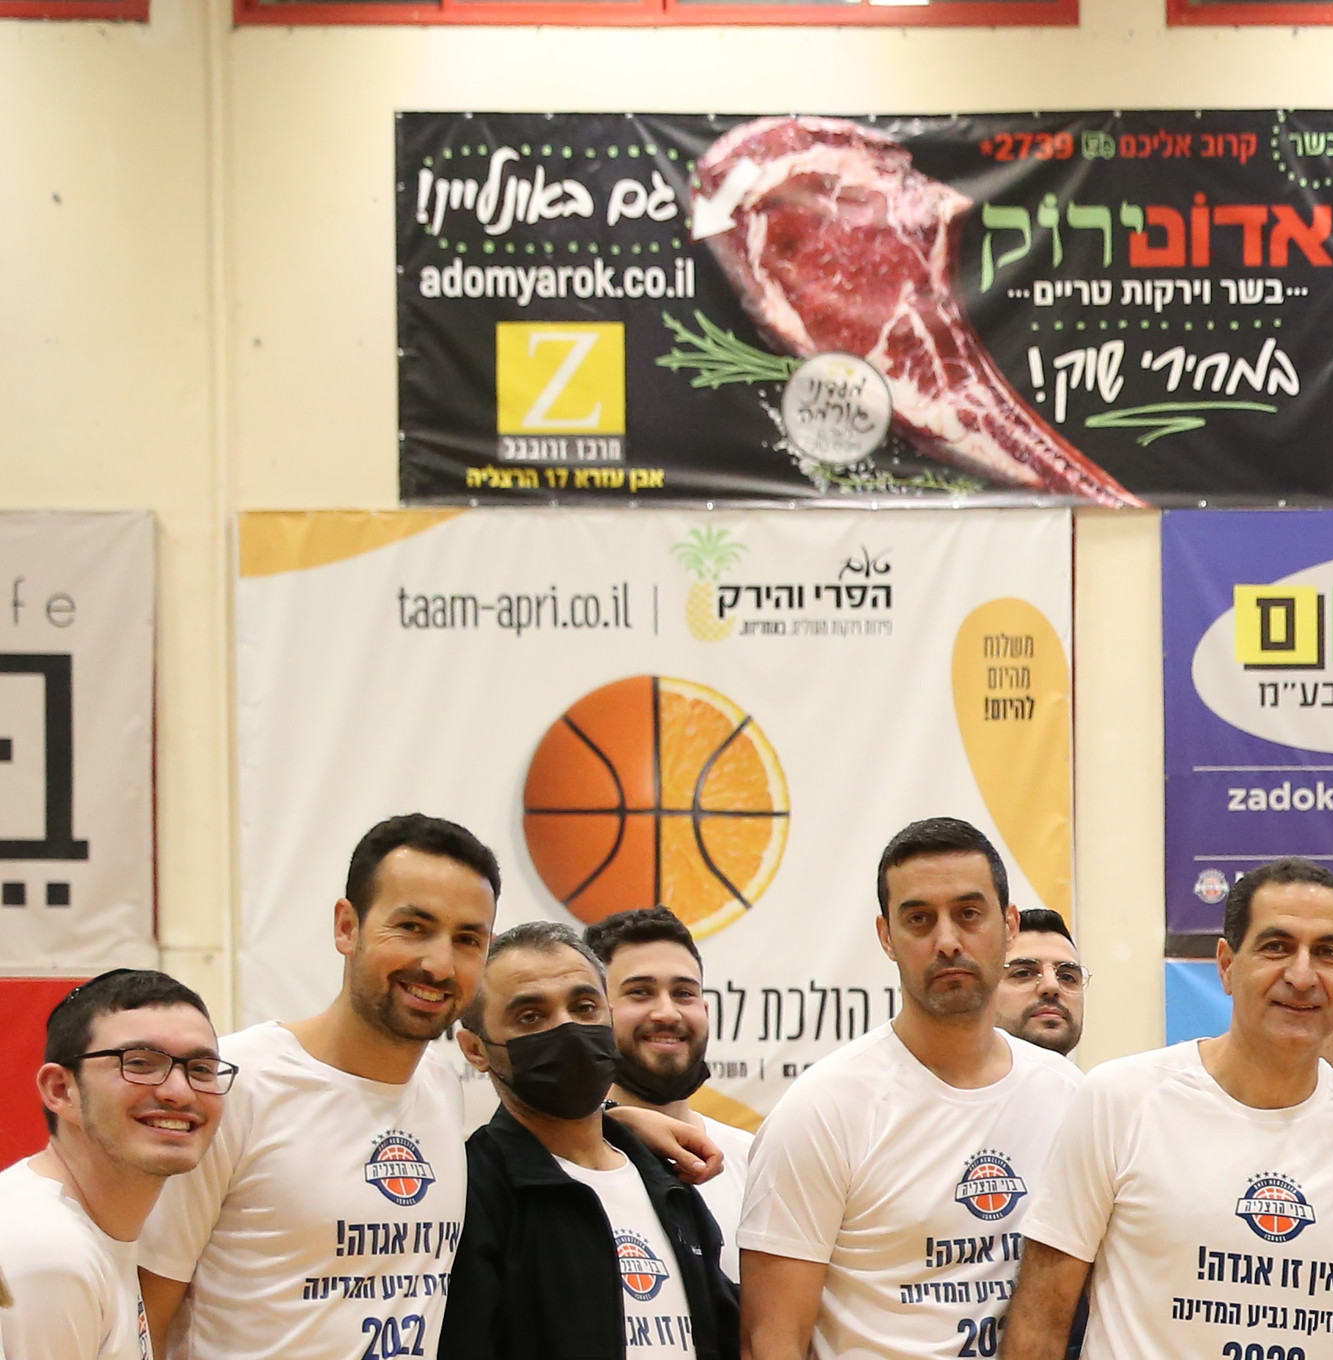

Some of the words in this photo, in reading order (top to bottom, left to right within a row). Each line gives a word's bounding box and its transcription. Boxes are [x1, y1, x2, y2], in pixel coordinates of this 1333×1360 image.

[1120, 130, 1191, 159] אליכם
[1202, 131, 1257, 165] קרוב
[607, 171, 678, 226] גם
[420, 258, 694, 306] adomyarok.co.il
[1121, 279, 1211, 312] וירקות
[521, 332, 603, 428] Z
[1141, 338, 1299, 395] במחירי
[1028, 340, 1124, 423] שוק!
[629, 469, 664, 492] אבן
[398, 582, 632, 636] taam-apri.co.il
[718, 585, 804, 619] והירק
[815, 585, 891, 608] הפרי
[984, 633, 1034, 658] משלוח
[988, 666, 1030, 689] מהיום
[985, 696, 1034, 721] להיום!
[758, 980, 870, 1041] הולכת
[373, 1163, 407, 1177] הרצליה
[411, 1164, 426, 1176] בני
[963, 1180, 997, 1195] הרצליה
[1001, 1179, 1017, 1191] בני
[1245, 1201, 1285, 1214] הרצליה
[1290, 1204, 1306, 1217] בני
[336, 1220, 408, 1256] אגדה!
[413, 1222, 433, 1253] זו
[926, 1235, 995, 1268] אגדה!
[1001, 1232, 1022, 1261] זו
[621, 1260, 642, 1272] הרצל
[644, 1261, 661, 1273] בני
[1197, 1246, 1273, 1286] אגדה!
[1281, 1259, 1303, 1288] זו
[304, 1275, 376, 1300] המדינה
[382, 1274, 419, 1300] גביע
[900, 1280, 971, 1304] המדינה
[1172, 1297, 1241, 1325] המדינה
[1247, 1304, 1288, 1330] גביע
[626, 1316, 649, 1346] אג
[654, 1317, 676, 1346] זו
[957, 1315, 1006, 1357] 20
